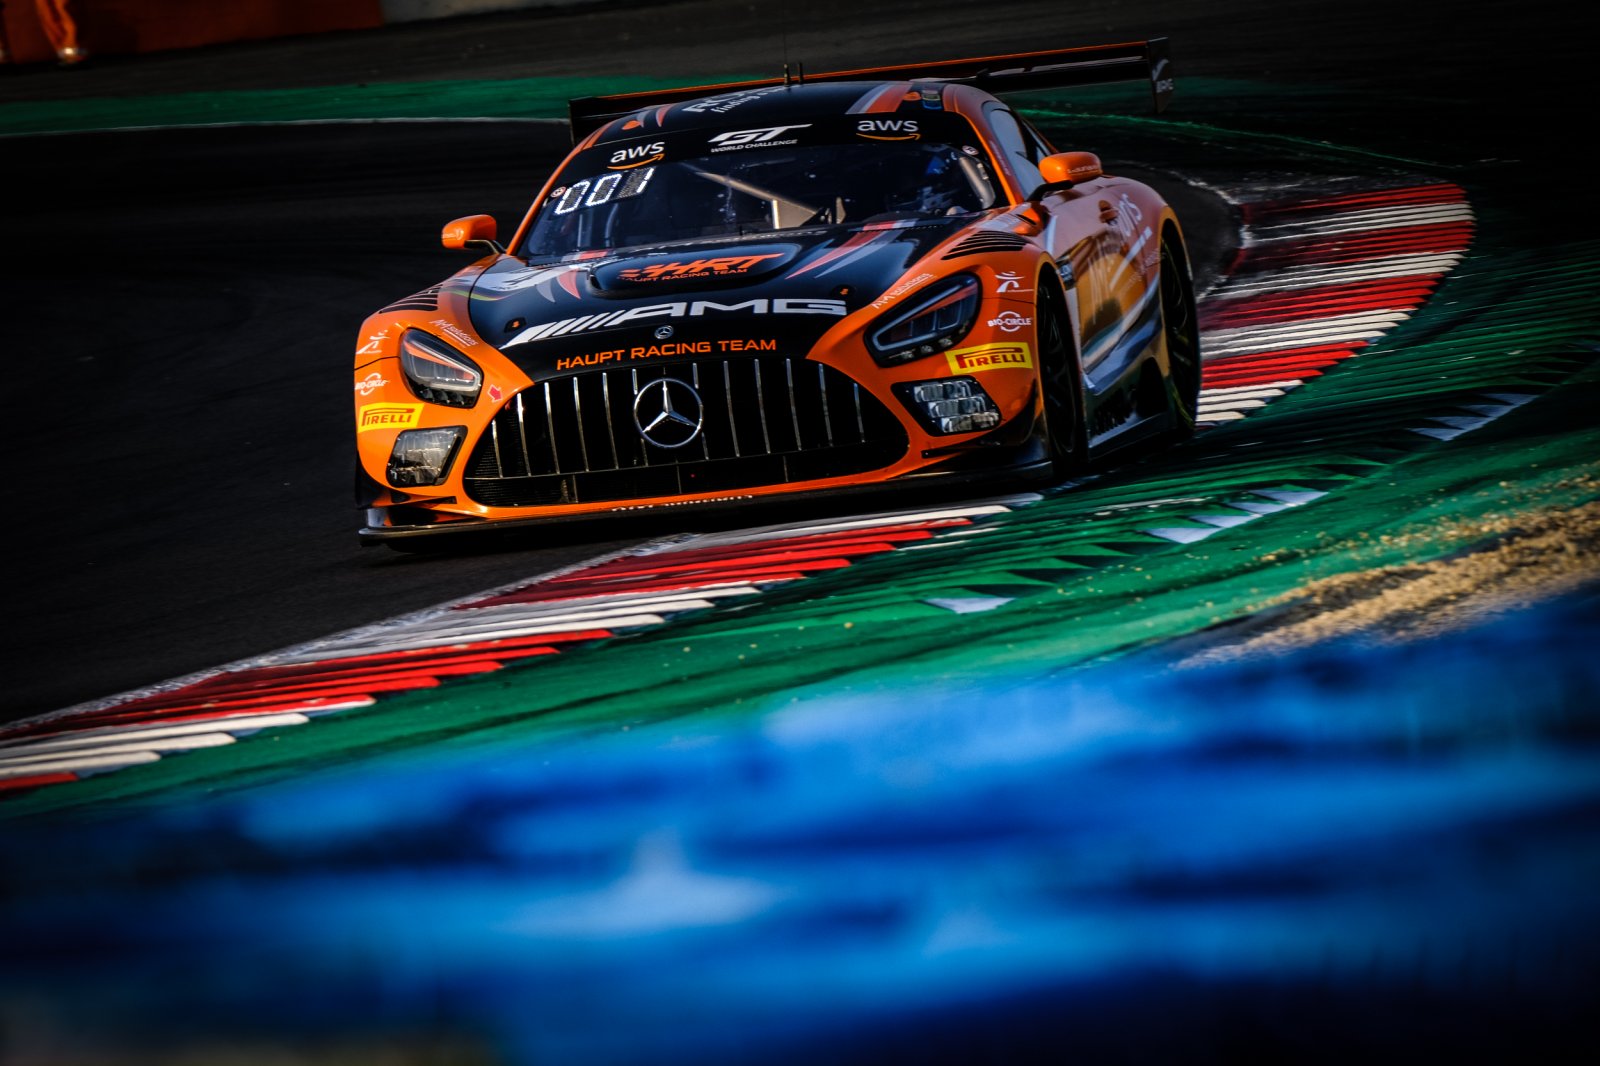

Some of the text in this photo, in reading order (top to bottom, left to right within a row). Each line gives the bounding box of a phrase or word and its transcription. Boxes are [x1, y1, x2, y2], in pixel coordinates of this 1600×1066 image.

[707, 123, 814, 146] GT
[857, 119, 919, 132] aws
[609, 141, 665, 163] aws
[710, 138, 799, 153] WORLD CHALLENGE
[661, 271, 709, 281] RACING
[604, 298, 847, 327] AMG
[987, 317, 1032, 327] BIO-CIRCLE
[556, 339, 777, 371] HAUPT RACING TEAM
[956, 347, 1025, 369] PIRELLI
[361, 408, 416, 427] PIRELLI
